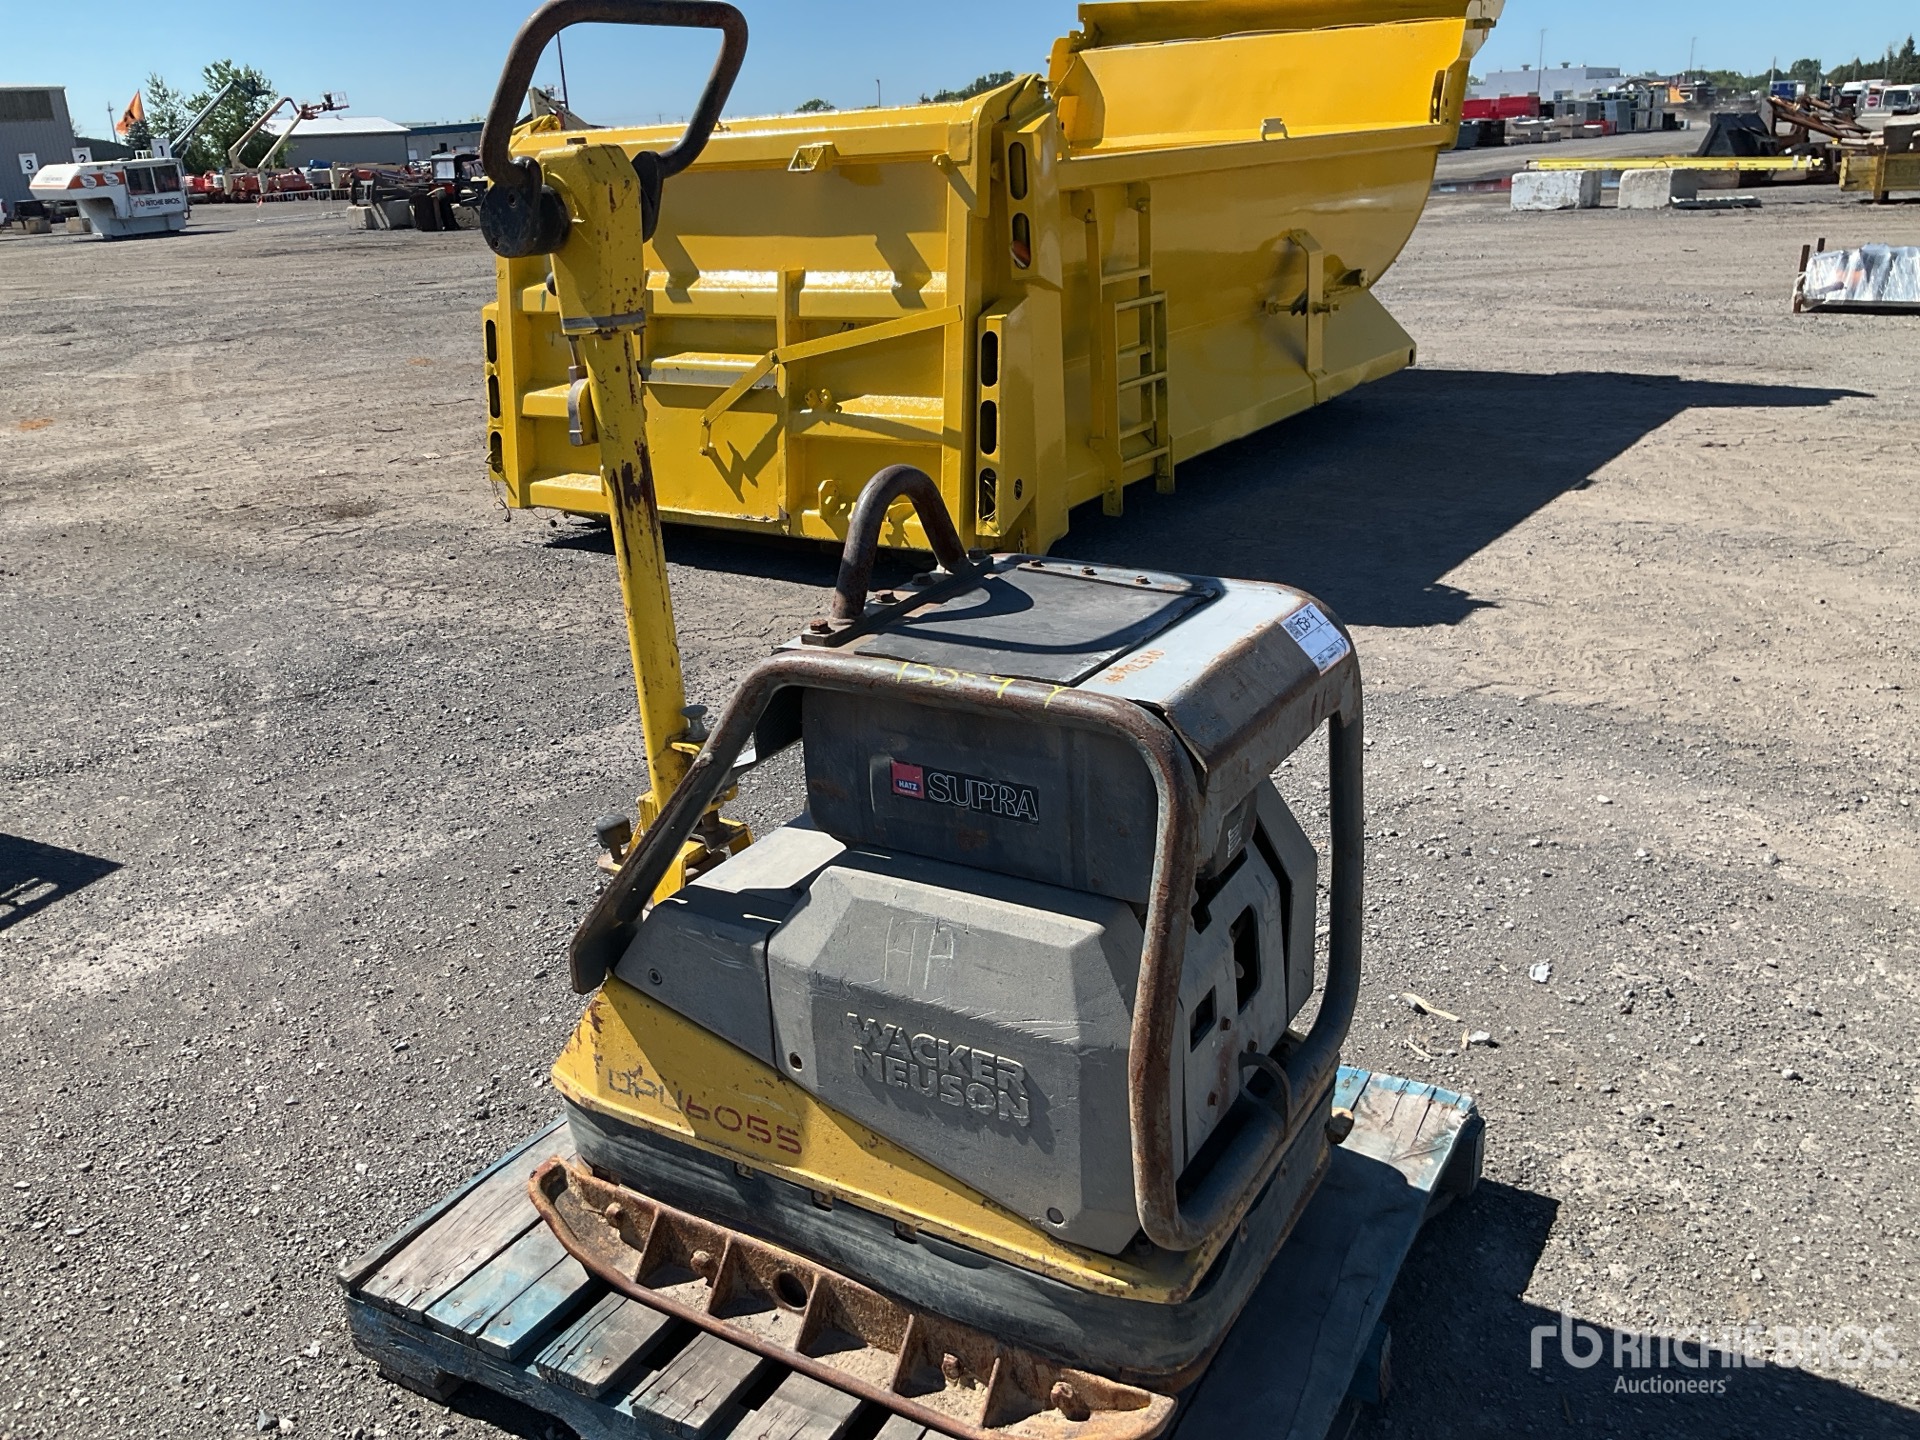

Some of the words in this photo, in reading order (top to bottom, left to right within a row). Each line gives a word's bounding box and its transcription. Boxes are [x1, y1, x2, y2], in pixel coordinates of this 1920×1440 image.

[158, 145, 165, 157] 1
[78, 153, 87, 163] 2
[25, 159, 34, 170] 3
[897, 779, 919, 791] HATZ
[927, 772, 1039, 821] SUPRA
[847, 1012, 1029, 1099] WACKER
[853, 1046, 1030, 1127] NEUSON
